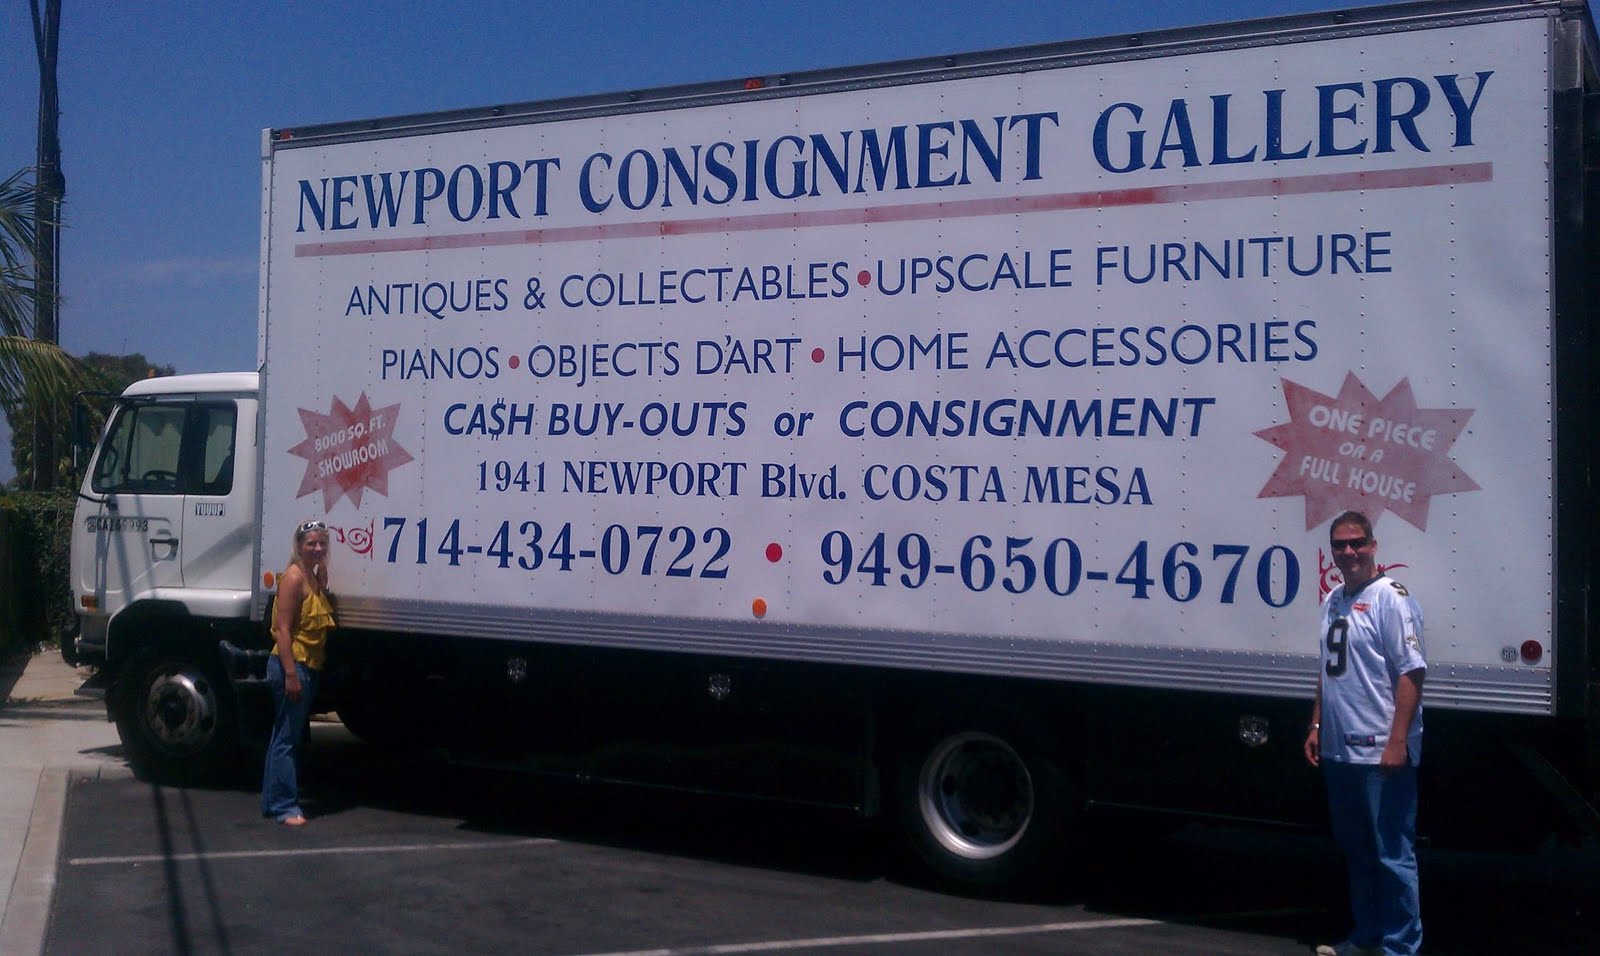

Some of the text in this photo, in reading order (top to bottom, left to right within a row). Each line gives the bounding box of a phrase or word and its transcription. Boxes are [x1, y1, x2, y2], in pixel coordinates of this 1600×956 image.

[296, 71, 1494, 232] NEWPORT CONSIGNMENT GALLERY
[345, 231, 1392, 320] ANTIQUES & COLLECTABLES UPSCALE FURNITURE
[382, 320, 1318, 387] PIANOS OBJECTS D'ART HOME ACCESSORIES
[315, 414, 386, 453] 8000 SQ. FT.
[444, 397, 1216, 441] CA$H BUY-OUTS or CONSIGNMENT
[1309, 405, 1437, 451] ONE PIECE
[318, 439, 389, 478] SHOWROOM
[1339, 442, 1384, 463] OR A
[478, 460, 1153, 505] 1941 NEWPORT Blvd. COSTA MESA
[1299, 455, 1416, 504] FULL HOUSE
[383, 516, 1301, 608] 714-434-0722 949-650-4670
[1325, 617, 1350, 678] 9
